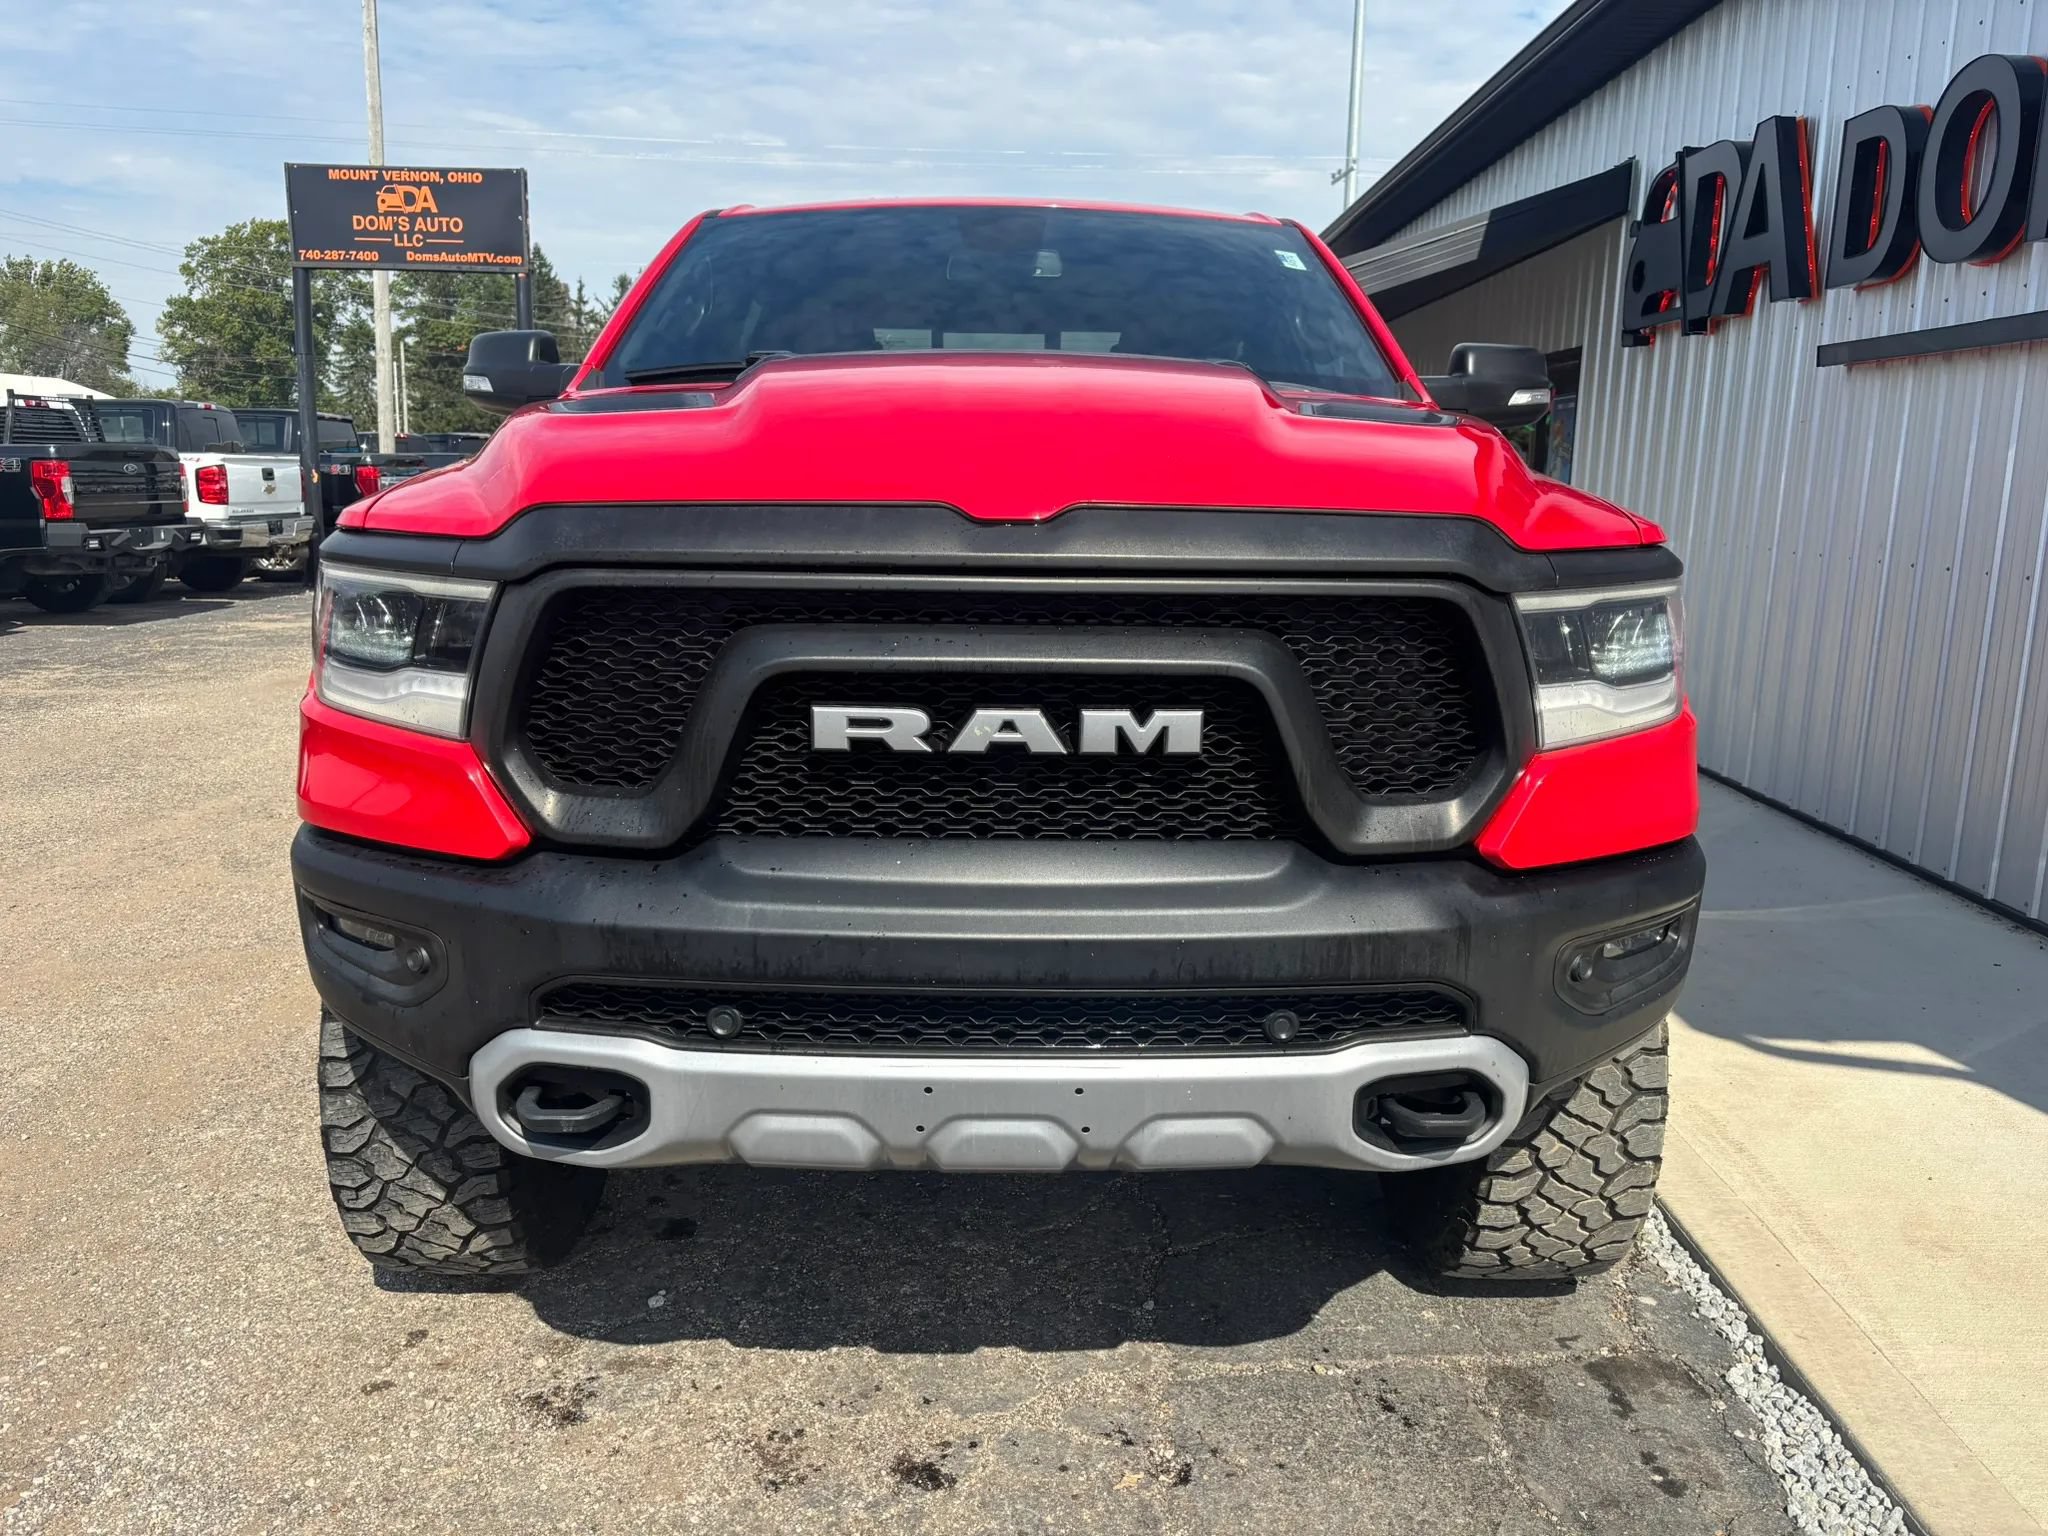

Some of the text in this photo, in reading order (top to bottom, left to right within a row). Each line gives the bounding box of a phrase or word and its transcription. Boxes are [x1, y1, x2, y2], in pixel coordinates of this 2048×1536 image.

[328, 169, 483, 184] MOUNT VERNON, OHIO
[1825, 53, 2048, 290] DO
[352, 215, 463, 233] DOM'S AUTO
[394, 234, 424, 247] LLC
[299, 249, 523, 265] 740-287-7400 DomsAutoMTV.com
[811, 705, 1203, 755] RAM
